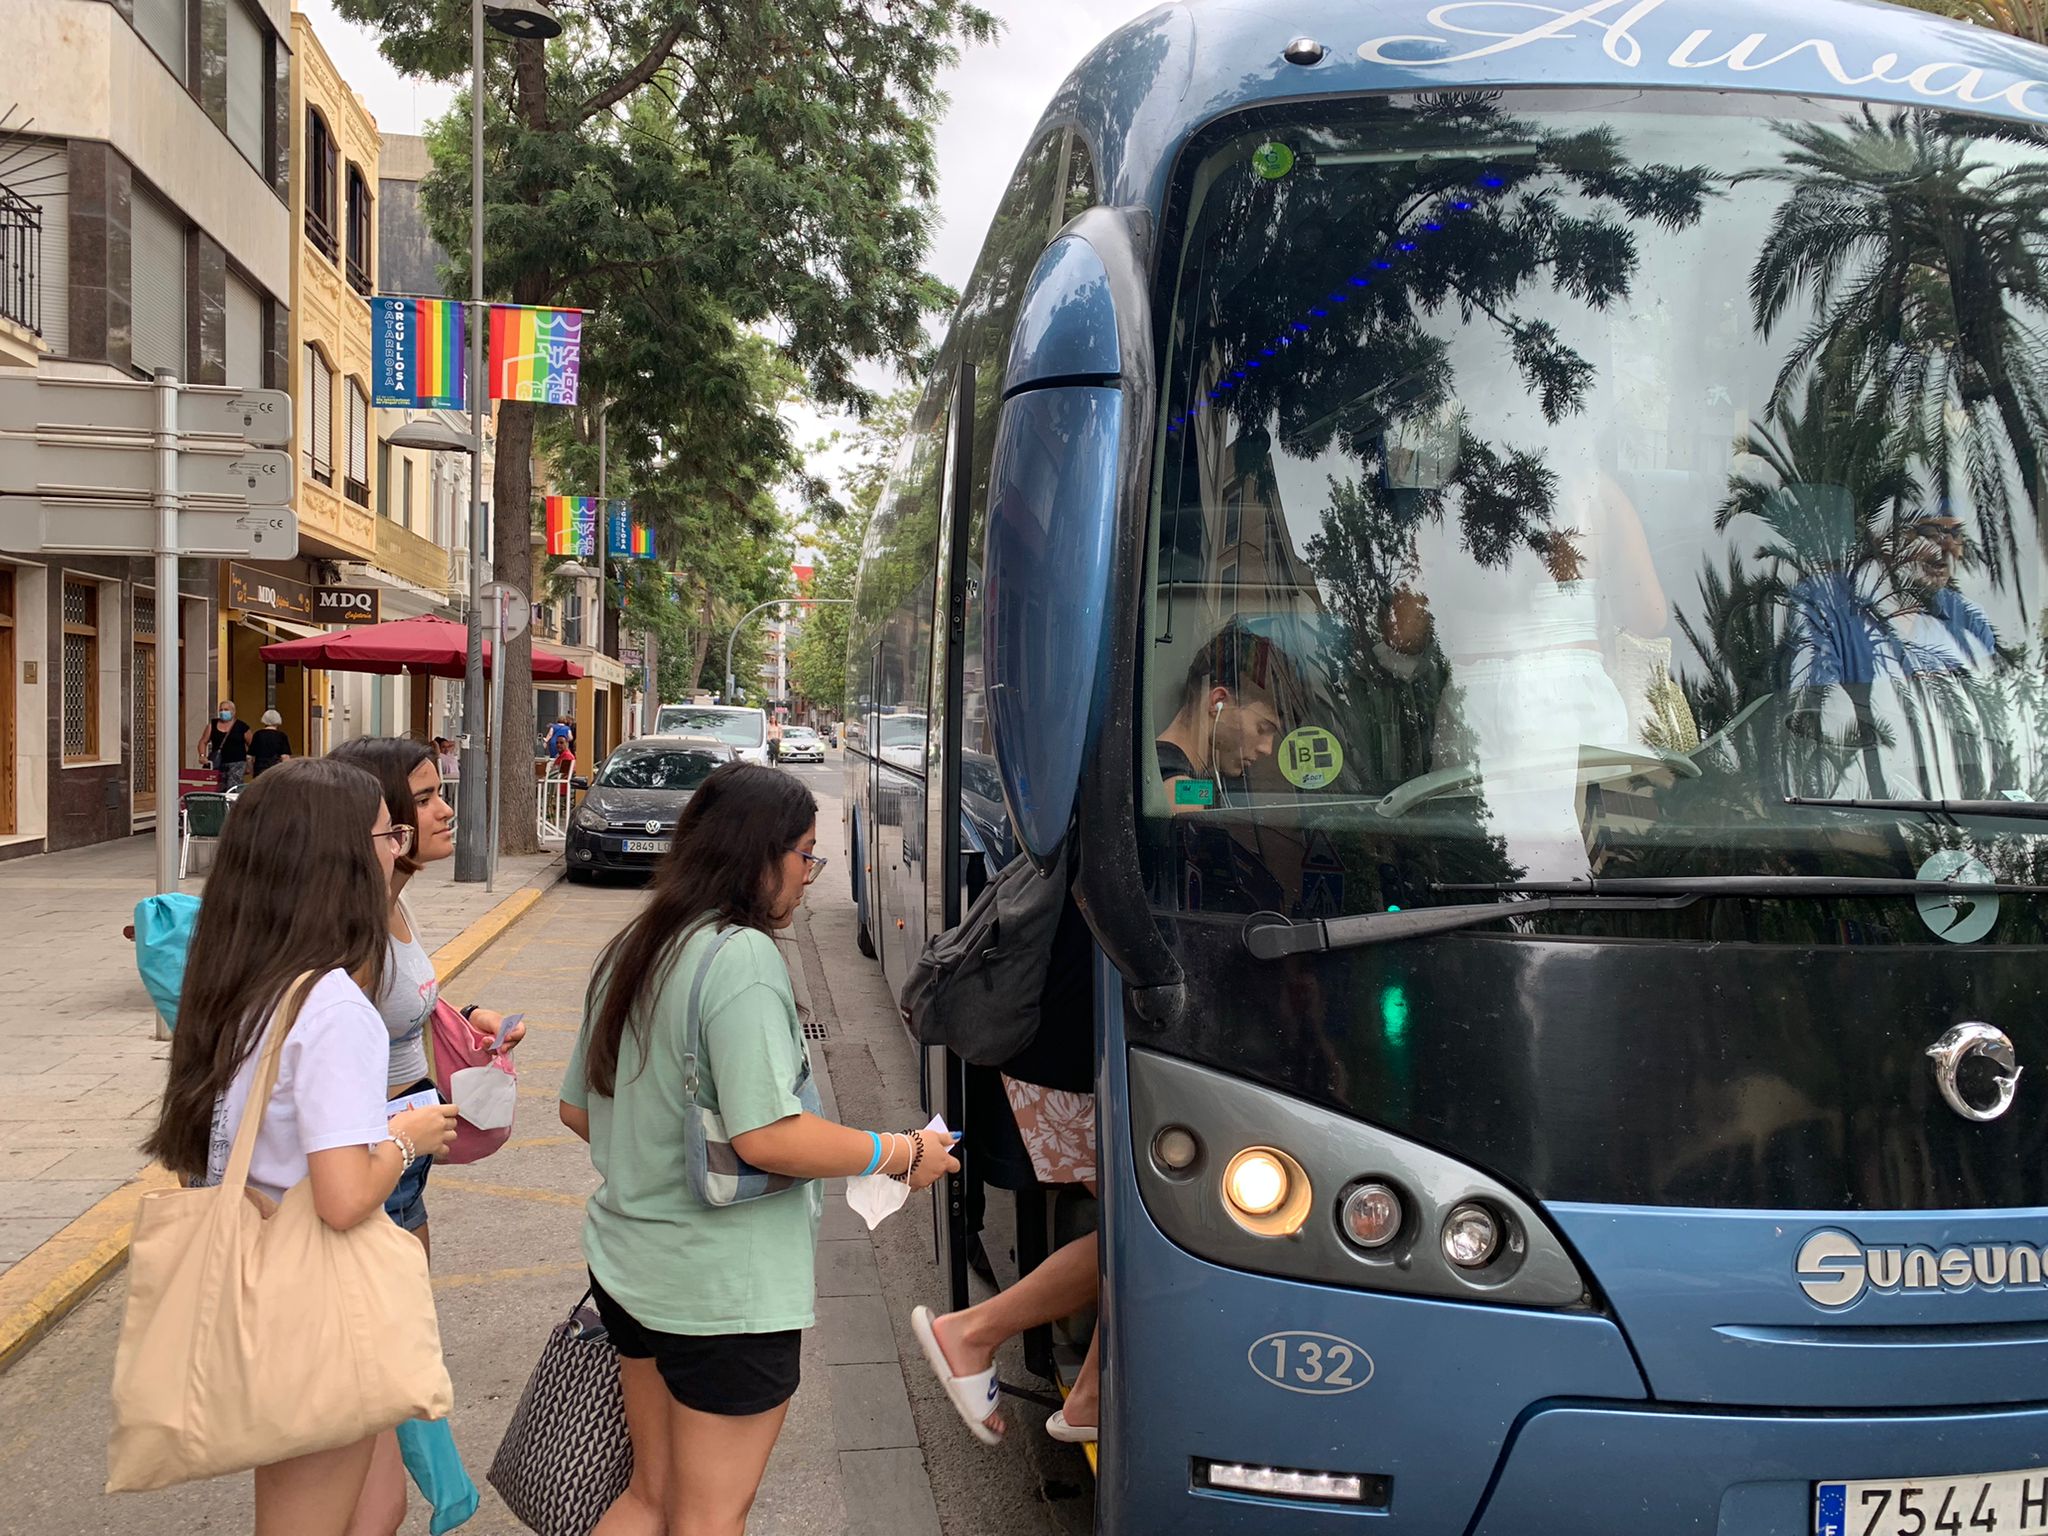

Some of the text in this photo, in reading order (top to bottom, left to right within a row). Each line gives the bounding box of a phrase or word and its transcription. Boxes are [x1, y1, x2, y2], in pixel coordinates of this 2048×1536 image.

[384, 301, 395, 386] CATARROJA
[394, 301, 405, 391] ORGULLOSA
[258, 585, 276, 609] MDQ
[319, 592, 372, 611] MDQ
[1300, 747, 1311, 763] B
[630, 842, 654, 851] 2849
[1270, 1339, 1353, 1386] 132
[1861, 1483, 1998, 1536] 7544
